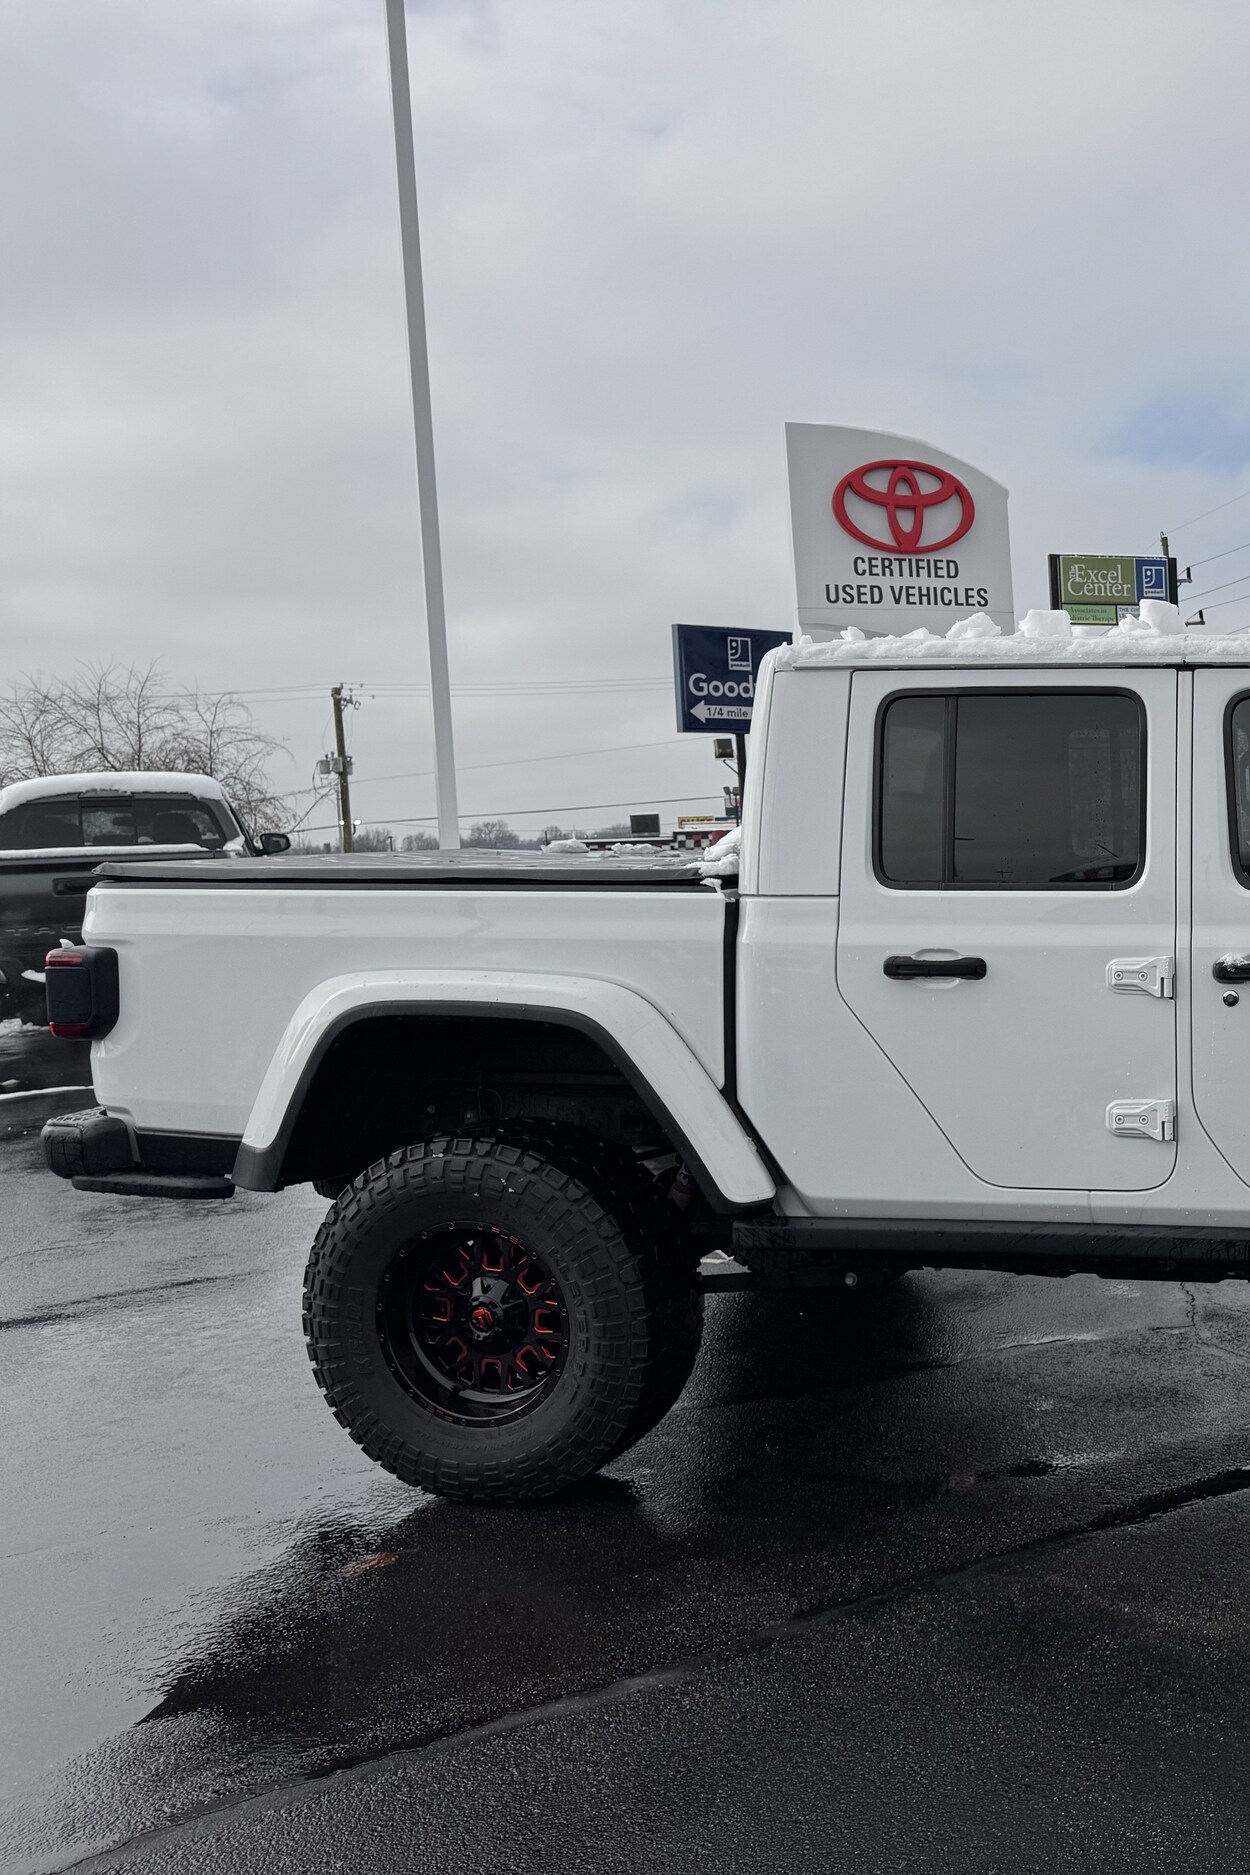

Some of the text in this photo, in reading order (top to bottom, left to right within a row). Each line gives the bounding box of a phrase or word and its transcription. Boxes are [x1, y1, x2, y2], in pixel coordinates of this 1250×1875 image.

[853, 556, 959, 579] CERTIFIED
[1073, 563, 1124, 583] Excel
[825, 584, 989, 607] USED VEHICLES
[1067, 577, 1132, 597] Center
[688, 672, 756, 698] Good
[707, 707, 748, 718] 1/4 mile
